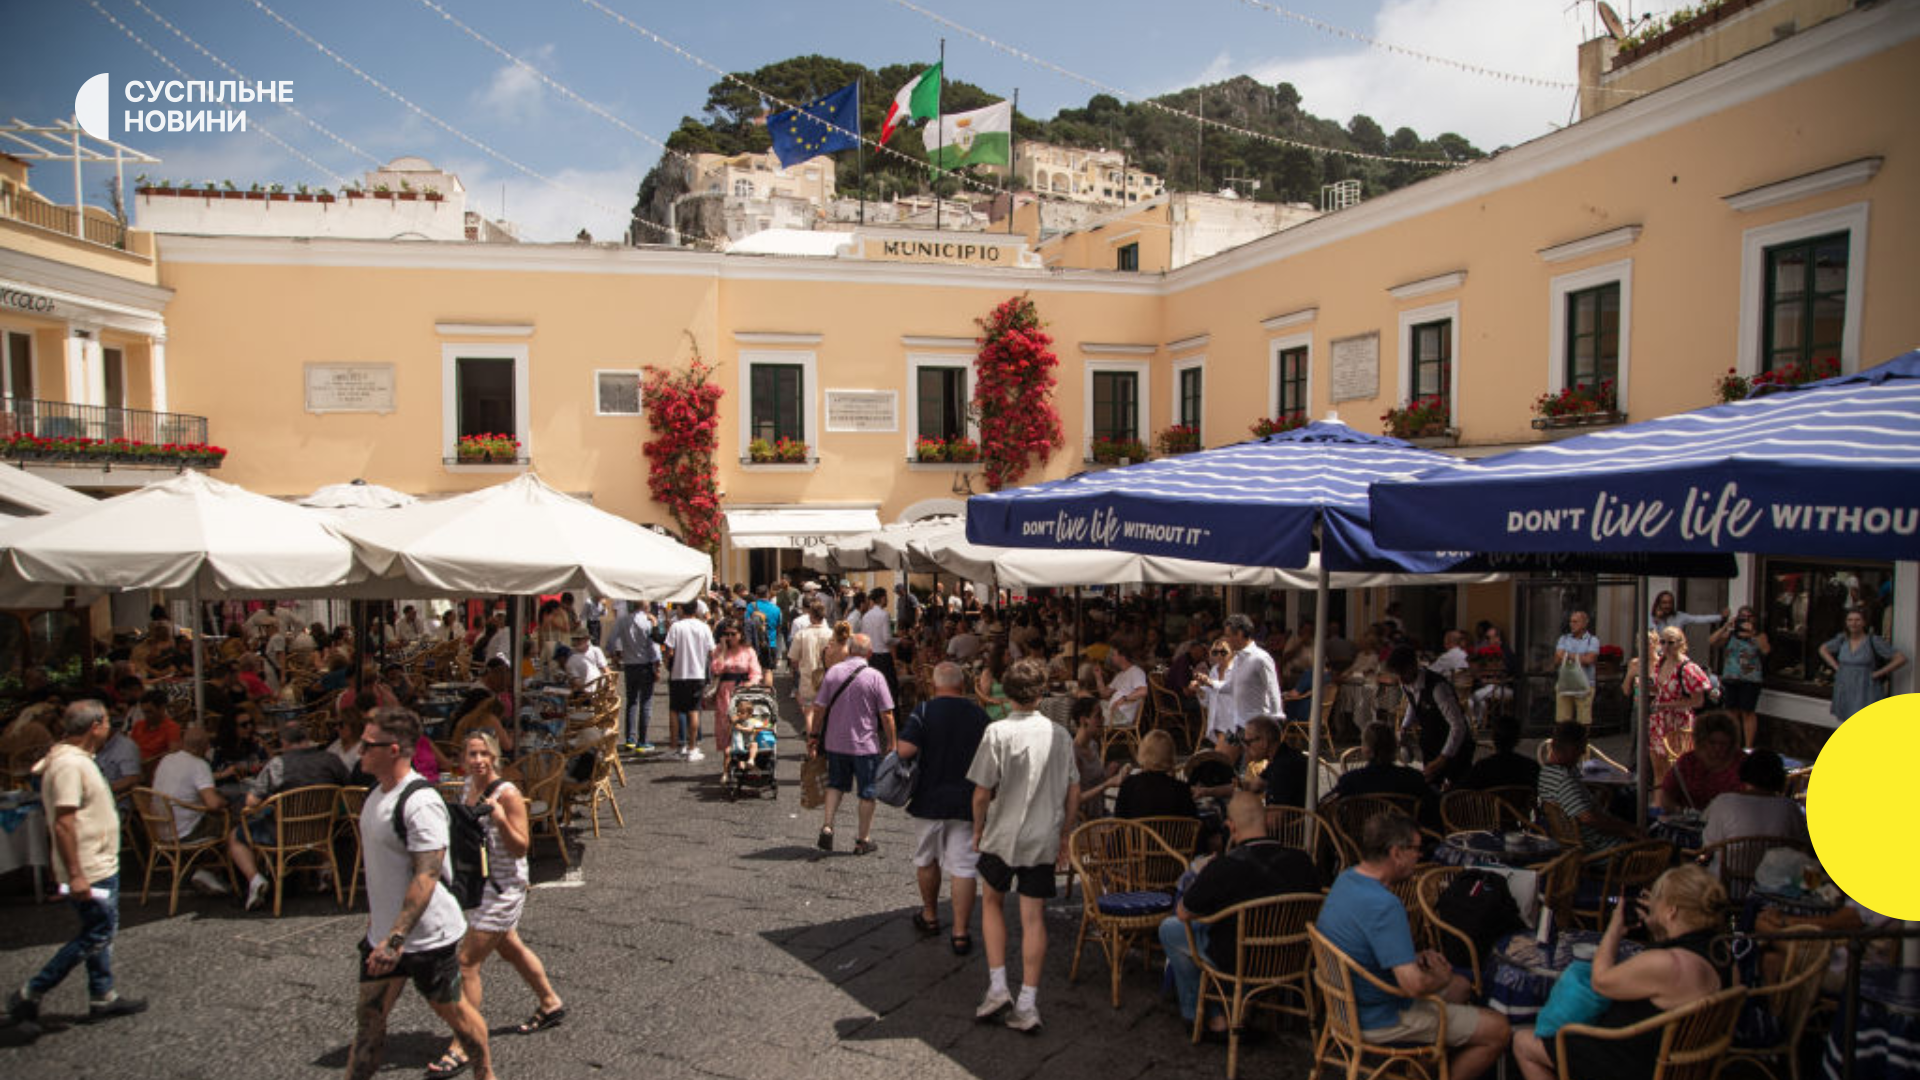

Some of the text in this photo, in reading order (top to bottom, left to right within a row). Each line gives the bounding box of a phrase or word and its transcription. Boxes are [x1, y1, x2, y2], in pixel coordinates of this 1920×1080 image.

[884, 241, 999, 261] MUNICIPIO
[1023, 521, 1055, 535] DON'T
[1056, 509, 1088, 543] live
[1091, 506, 1121, 547] life
[1124, 520, 1184, 543] WITHOUT
[1508, 482, 1919, 547] DON'T live life WITHOU
